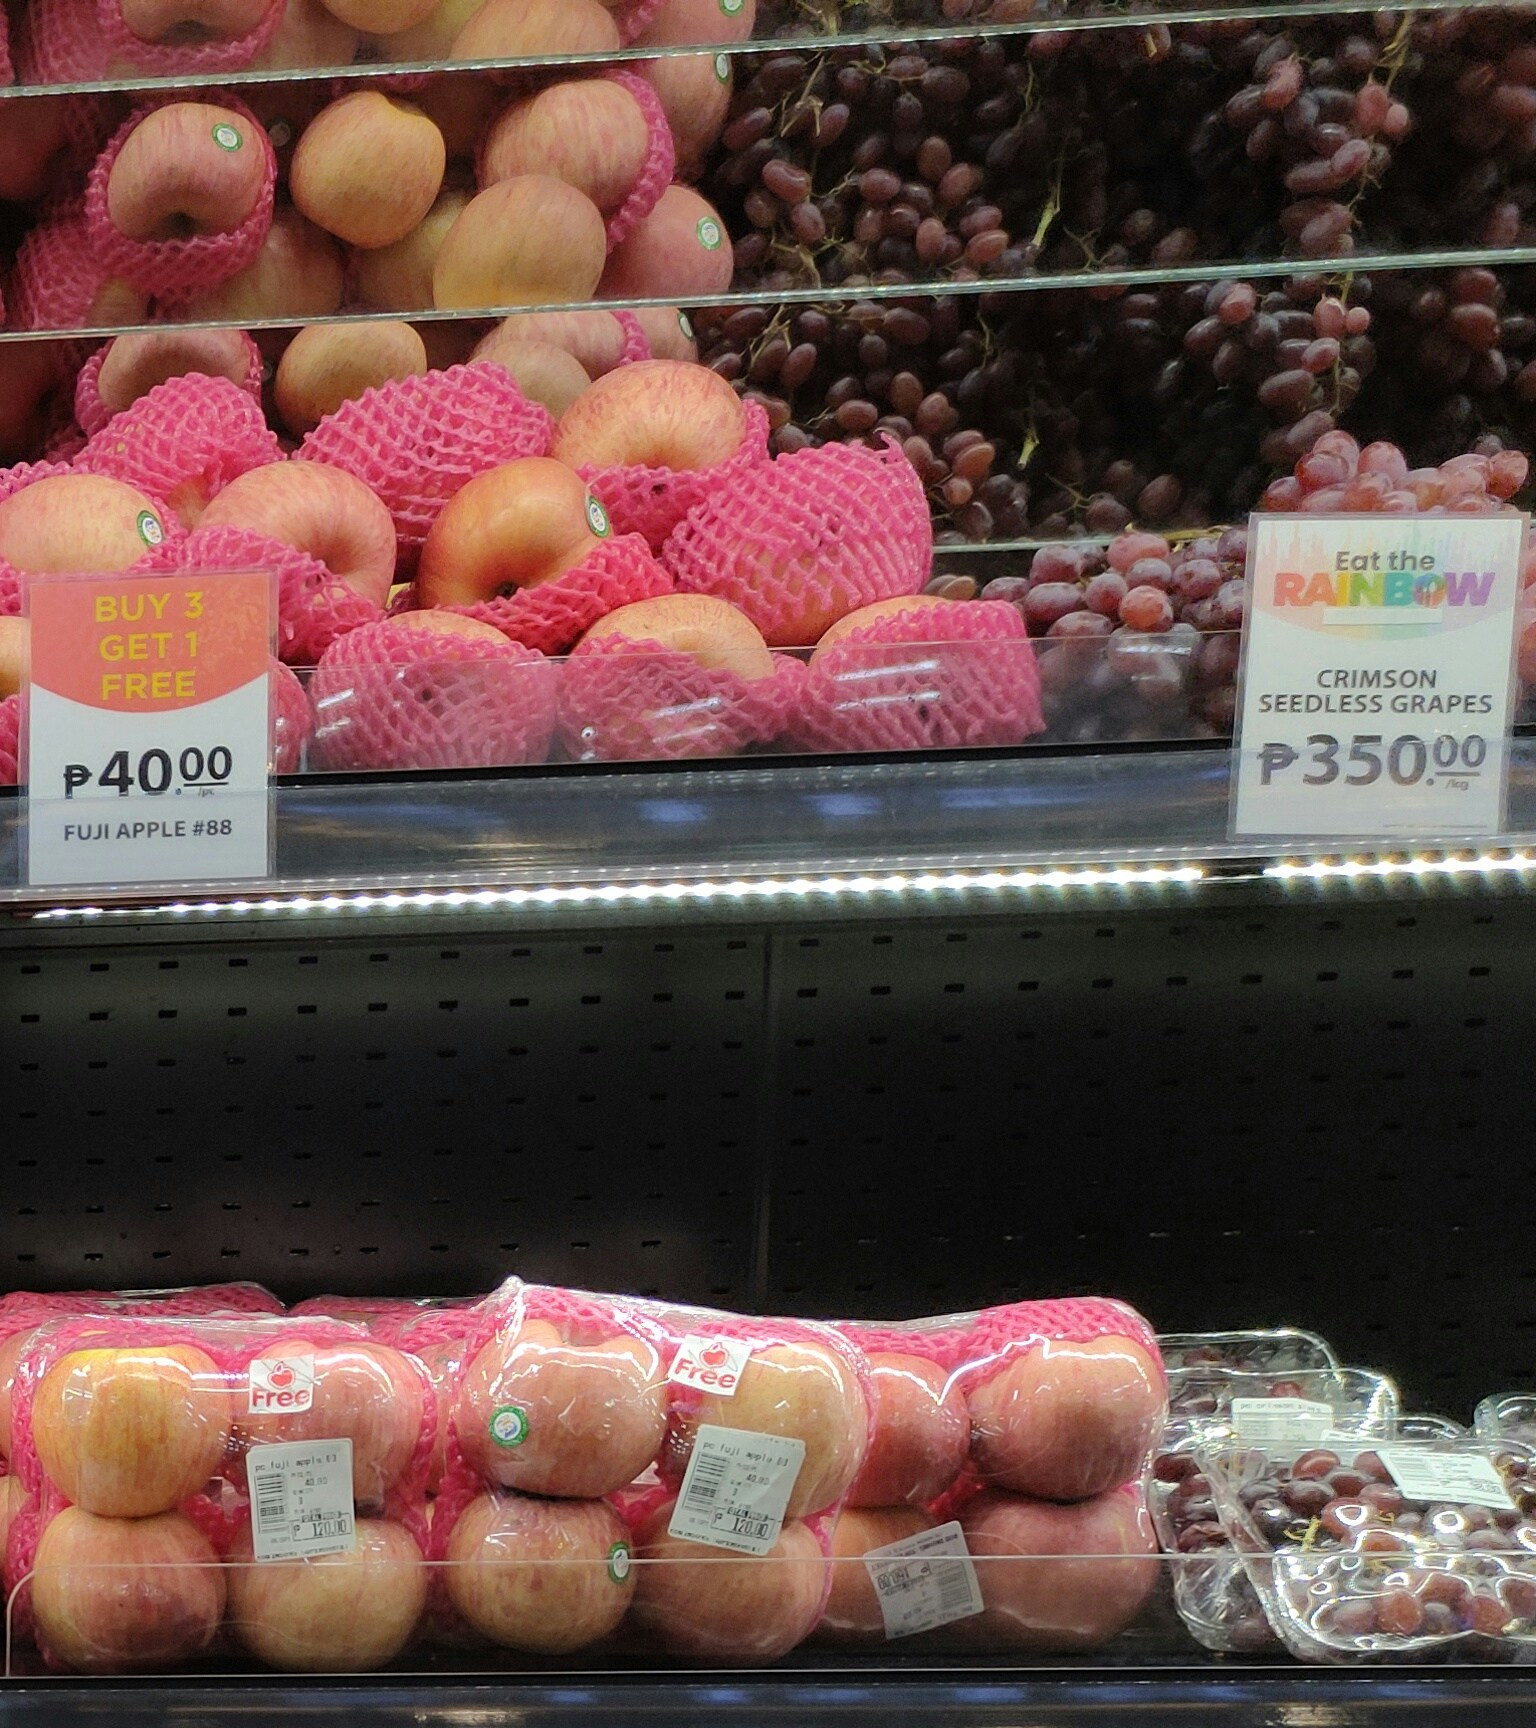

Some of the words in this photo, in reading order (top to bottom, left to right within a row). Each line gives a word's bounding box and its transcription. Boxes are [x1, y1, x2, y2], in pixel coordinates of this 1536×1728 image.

[1335, 550, 1380, 571] Eat
[1387, 550, 1435, 571] the
[1273, 572, 1495, 609] RAINBOW
[95, 593, 171, 623] BUY
[184, 591, 204, 619] 3
[99, 632, 173, 662] GET
[185, 631, 199, 657] 1
[102, 671, 197, 701] FREE
[1317, 669, 1438, 689] CRIMSON
[1258, 694, 1383, 714] SEEDLESS
[1390, 694, 1493, 714] GRAPES
[63, 822, 109, 841] FUJI
[115, 820, 187, 840] APPLE
[192, 819, 233, 837] #88
[675, 1358, 736, 1387] Free
[252, 1389, 310, 1407] Free
